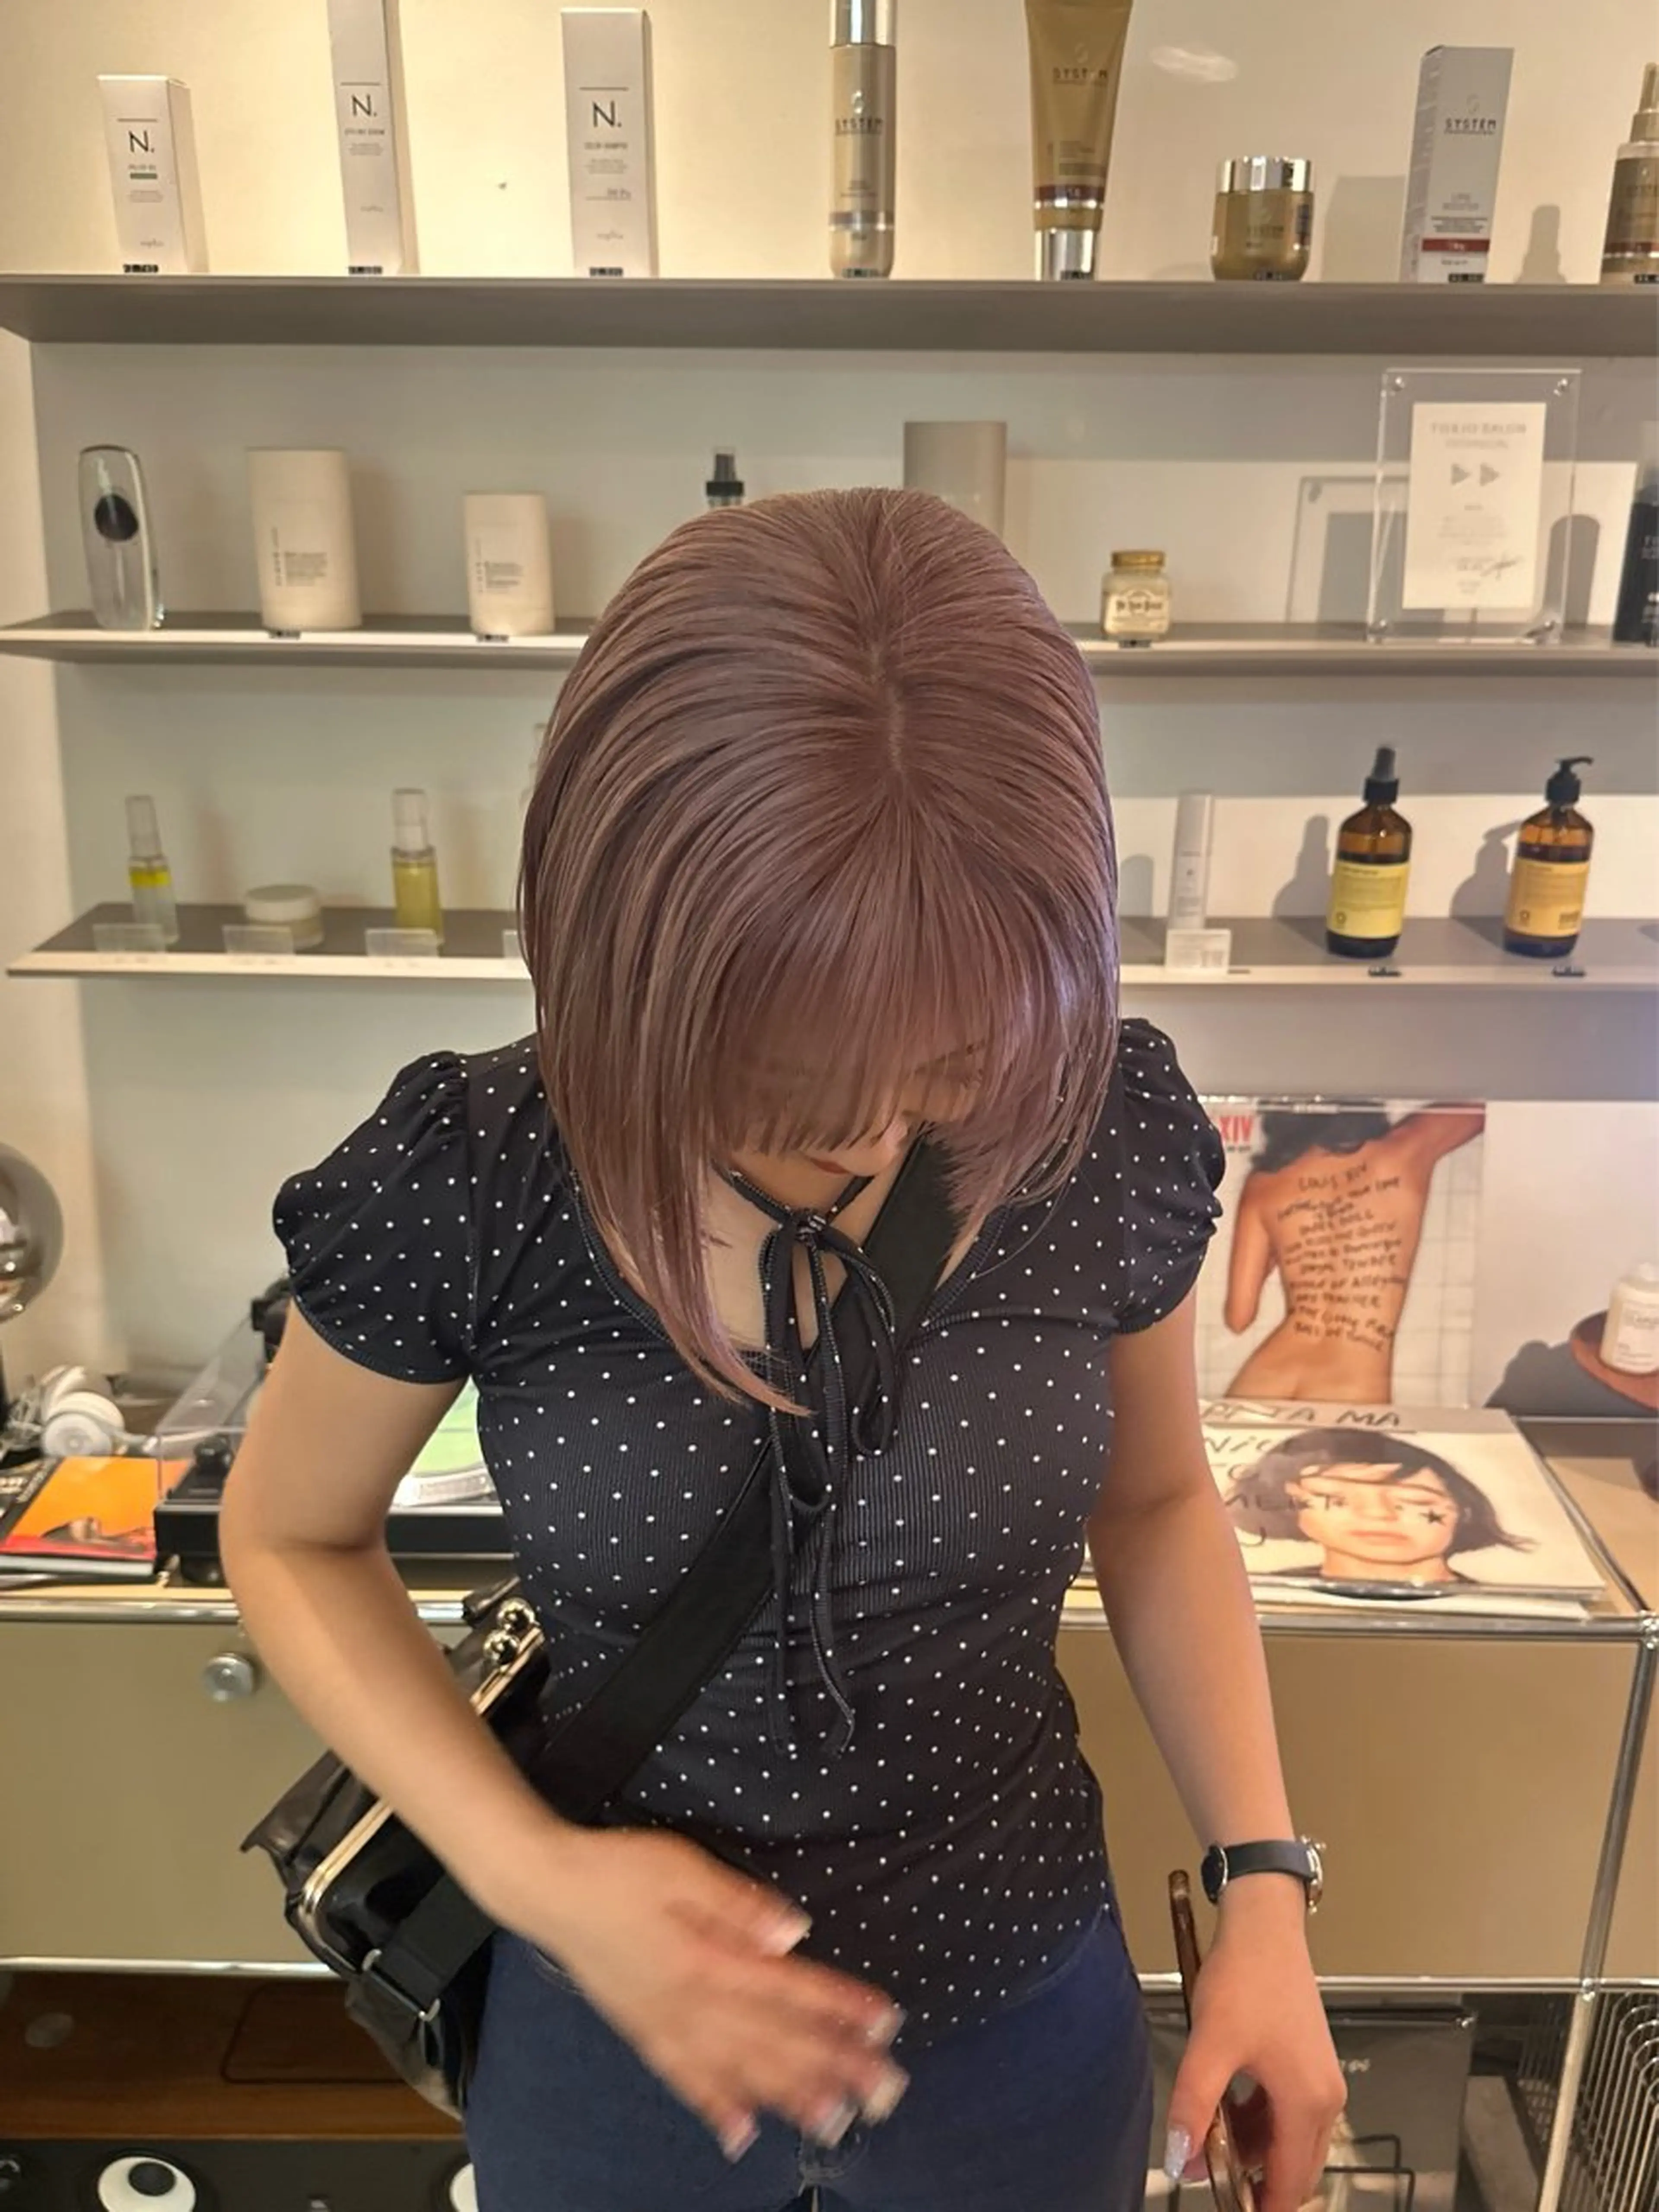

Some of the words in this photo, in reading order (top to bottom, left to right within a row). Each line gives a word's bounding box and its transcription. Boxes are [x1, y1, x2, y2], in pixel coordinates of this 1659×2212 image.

[352, 93, 377, 117] N.
[592, 100, 622, 127] N.
[128, 130, 155, 153] N.
